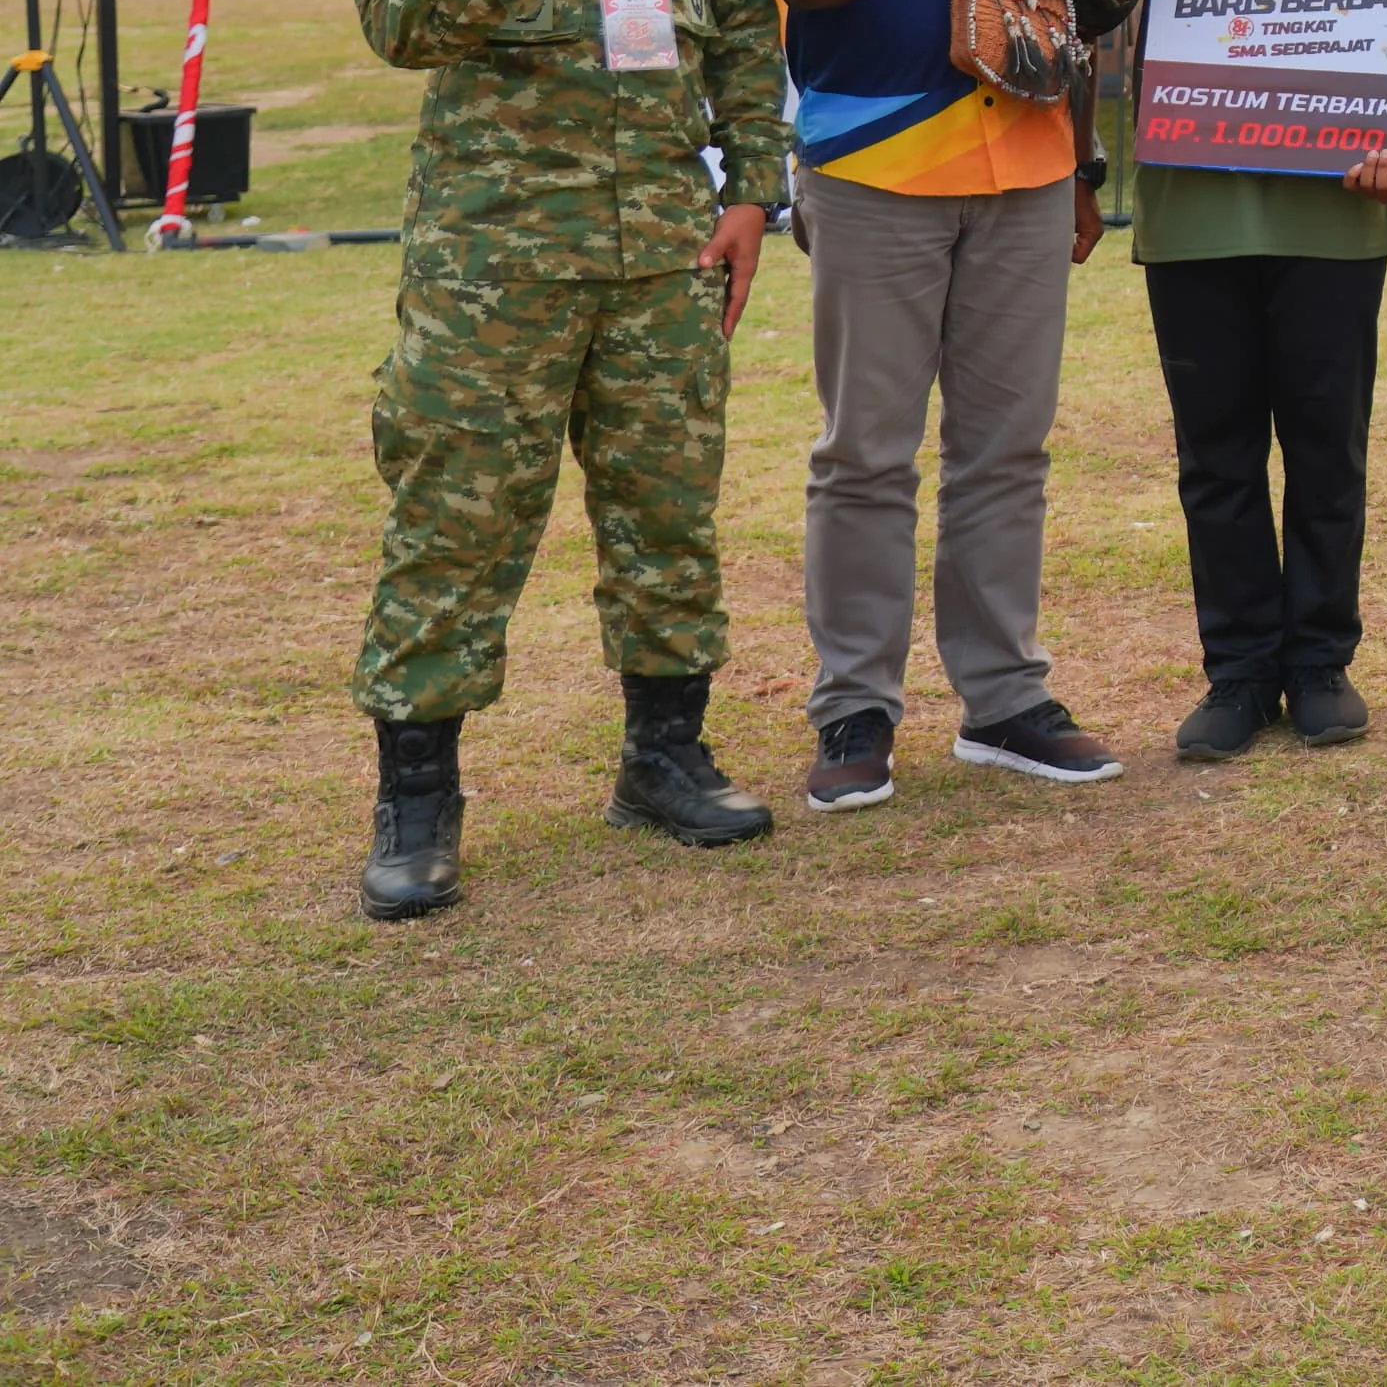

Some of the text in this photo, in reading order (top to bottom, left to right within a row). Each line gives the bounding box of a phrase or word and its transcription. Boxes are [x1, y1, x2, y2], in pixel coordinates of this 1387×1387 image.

[1262, 19, 1338, 35] TINGKAT
[1228, 38, 1375, 58] SMA SEDERAJAT
[1152, 85, 1270, 110] KOSTUM
[1146, 117, 1385, 151] RP. 1.000.000
